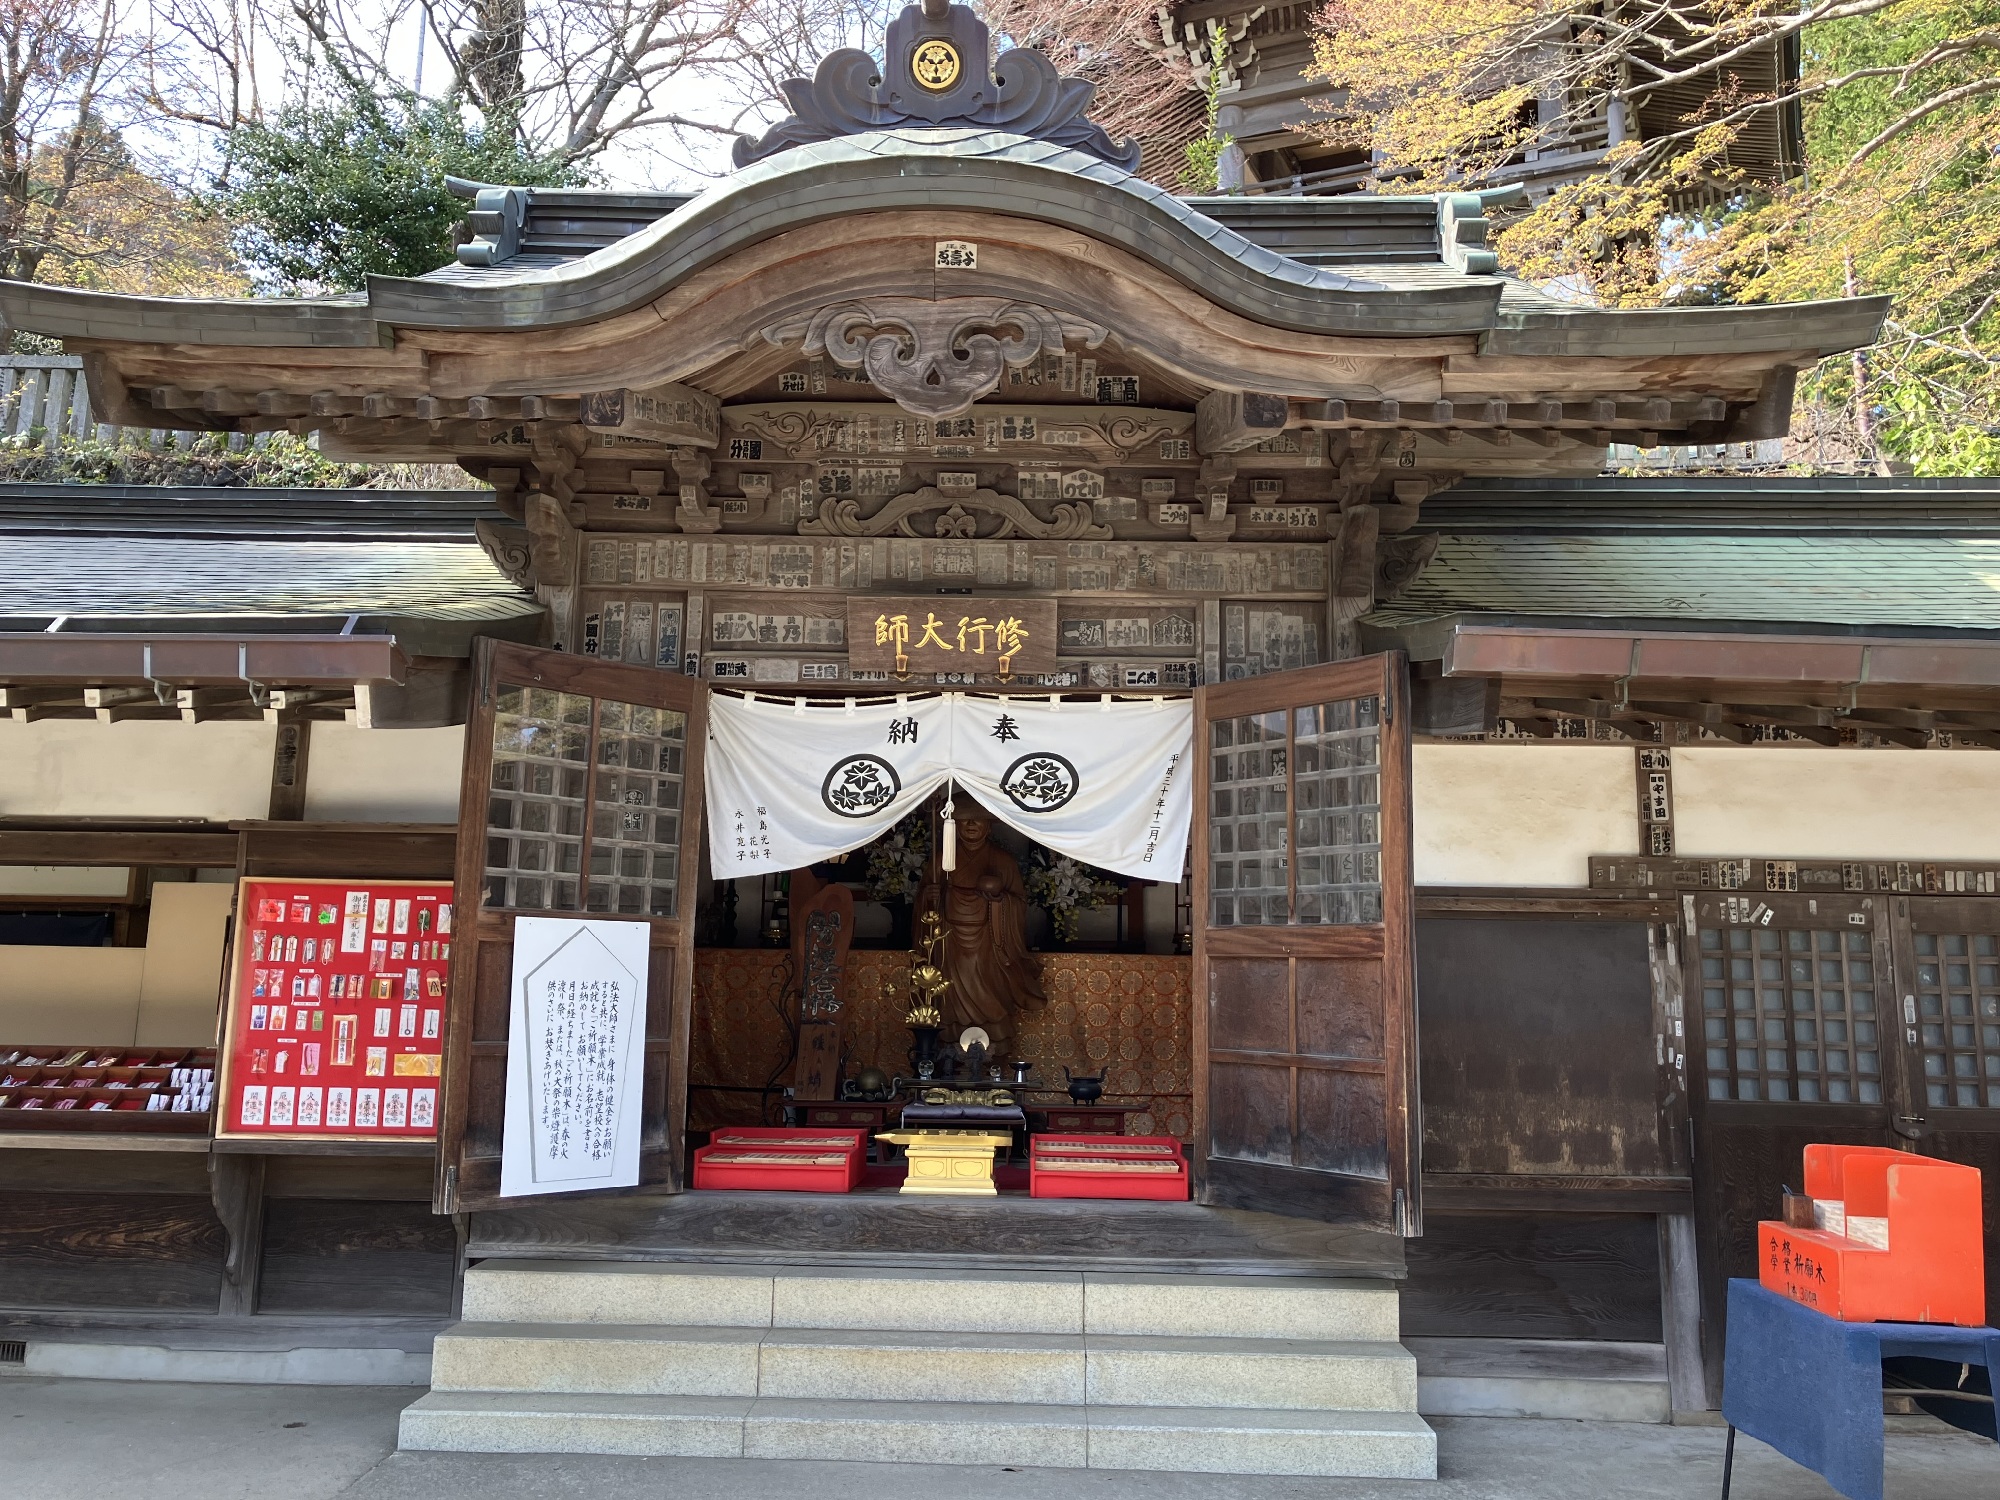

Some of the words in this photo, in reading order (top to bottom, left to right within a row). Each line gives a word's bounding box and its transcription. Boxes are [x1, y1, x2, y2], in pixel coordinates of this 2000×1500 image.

[887, 717, 918, 744] 納
[989, 714, 1020, 743] 奉
[1143, 753, 1179, 862] 平成三十年十二月吉日
[757, 806, 771, 858] 福島光子
[1794, 1252, 1826, 1287] 祈願木
